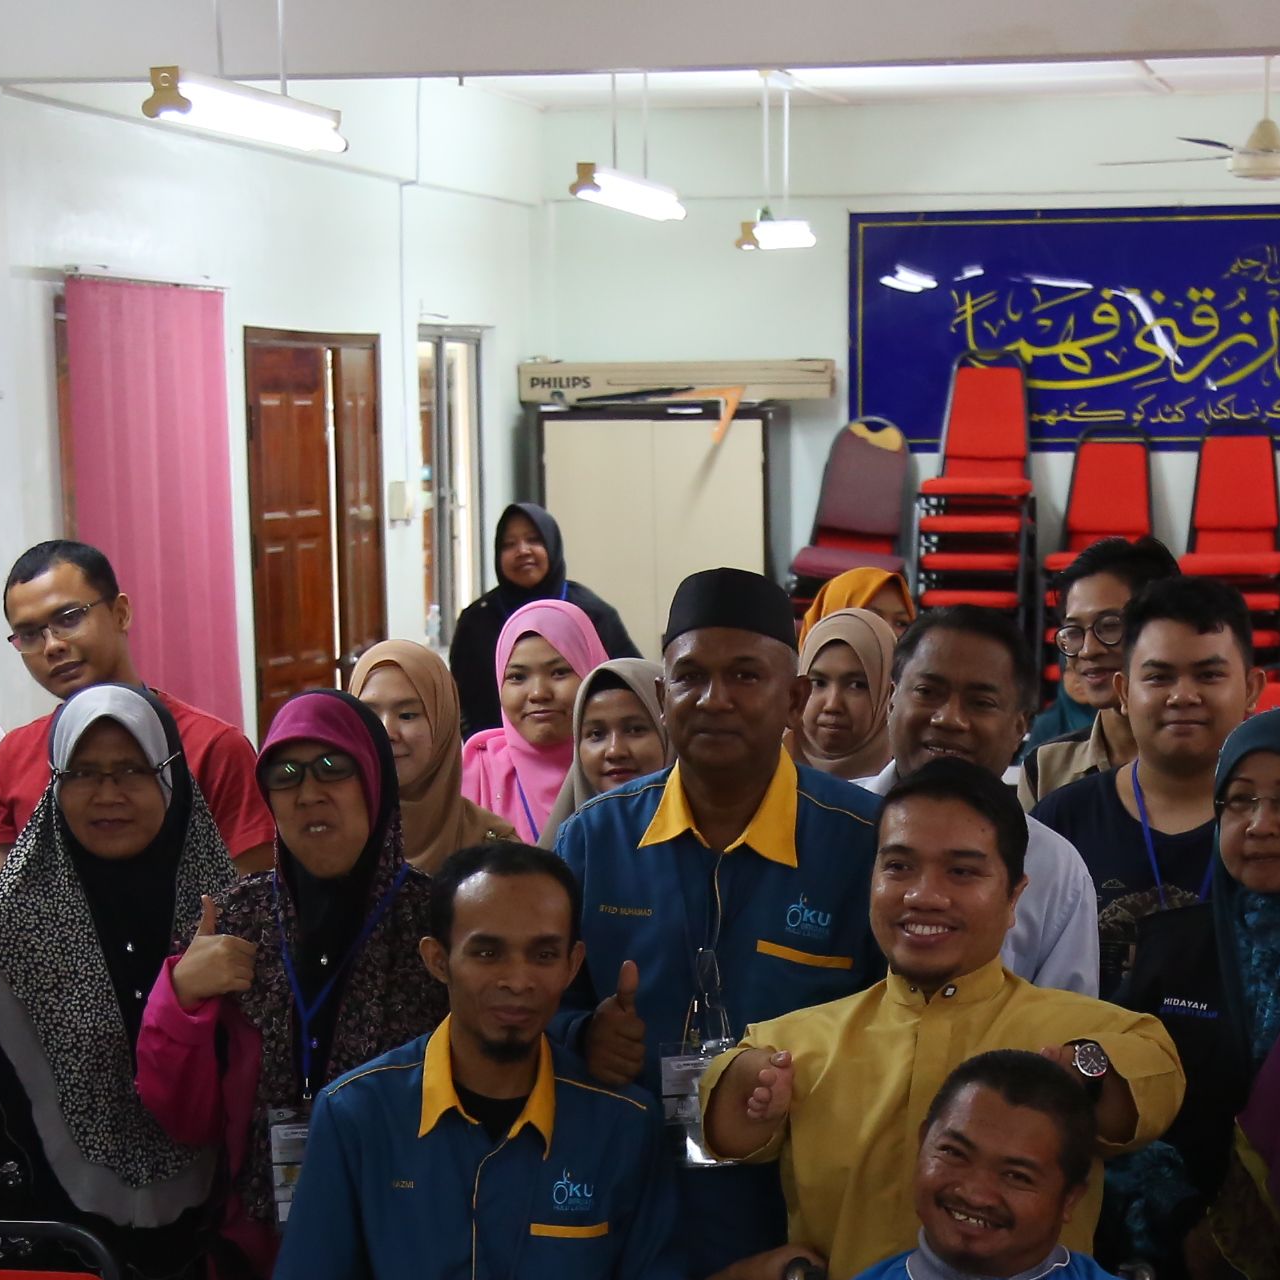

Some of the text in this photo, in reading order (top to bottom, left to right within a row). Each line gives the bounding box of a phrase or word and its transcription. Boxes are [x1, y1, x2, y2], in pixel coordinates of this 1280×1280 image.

[530, 375, 591, 390] PHILIPS
[786, 904, 832, 927] OKU
[1163, 998, 1208, 1011] HIDAYAH
[553, 1181, 595, 1205] OKU
